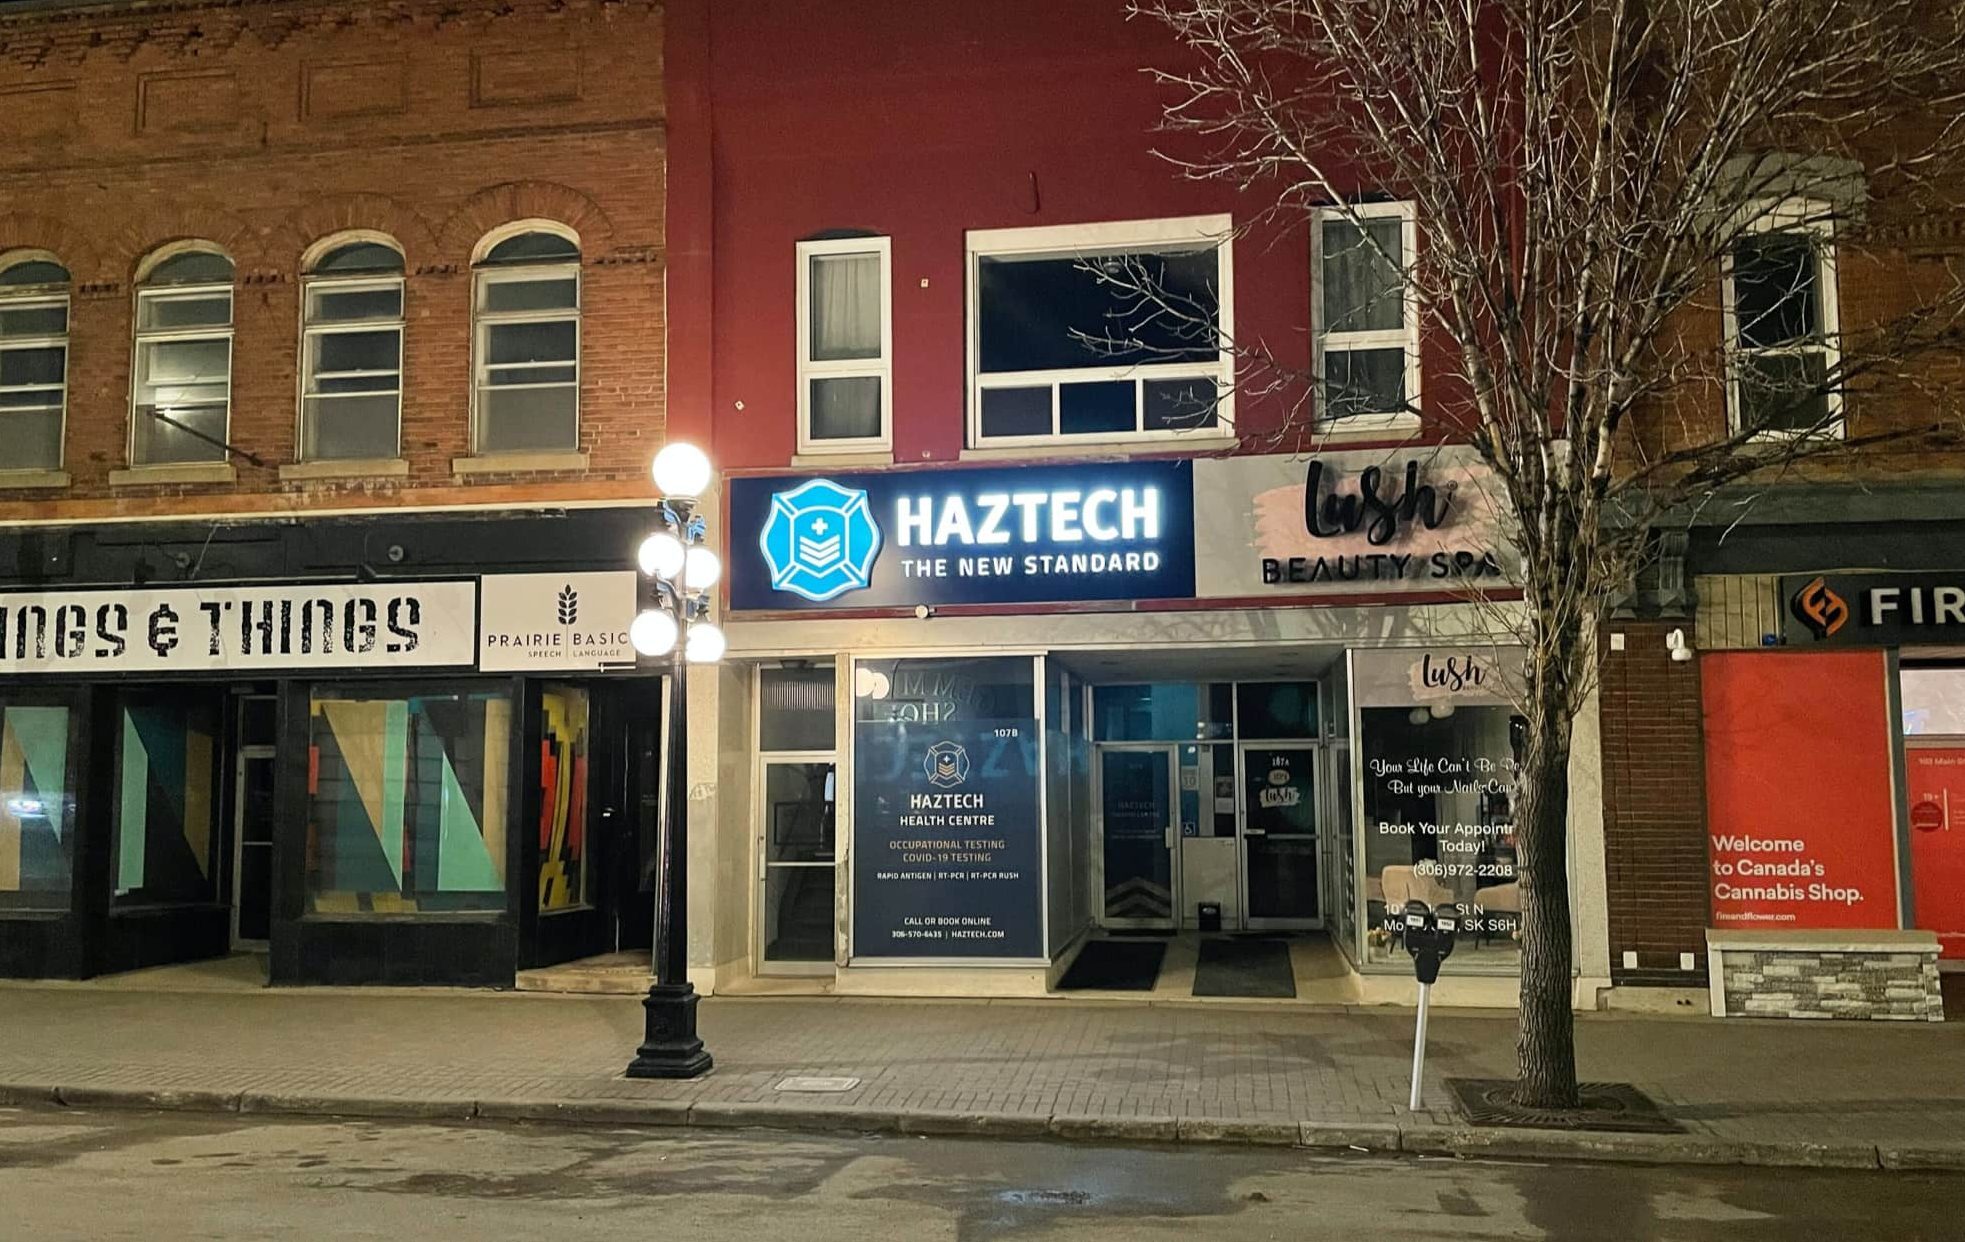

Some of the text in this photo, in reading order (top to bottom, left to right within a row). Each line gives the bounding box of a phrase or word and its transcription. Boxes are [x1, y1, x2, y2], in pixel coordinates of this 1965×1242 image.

[897, 488, 1159, 546] HAZTECH
[901, 551, 1160, 578] THE NEW STANDARD
[1262, 550, 1502, 584] BEAUTY SPA
[1870, 586, 1965, 625] FIR
[148, 603, 180, 658] &
[200, 596, 421, 656] THINGS
[488, 632, 562, 648] PRAIRIE
[528, 649, 621, 658] SPEECH LANGUAGE
[1370, 758, 1403, 777] Your
[1406, 757, 1435, 776] Life
[1437, 757, 1470, 773] Can't
[1474, 757, 1497, 772] Be
[1387, 779, 1414, 795] But
[1417, 784, 1442, 798] your
[911, 793, 984, 809] HAZTECH
[900, 815, 995, 826] HEALTH CENTRE
[1379, 822, 1416, 835] Book
[1418, 822, 1450, 835] Your
[889, 840, 1005, 849] OCCUPATIONAL TESTING
[1439, 840, 1485, 854] Today!
[1712, 835, 1805, 852] Welcome
[902, 853, 992, 862] COVID-19 TESTING
[1413, 864, 1513, 878] (306)972-2208
[1712, 859, 1825, 876] to Canada's
[877, 872, 1019, 880] RAPID ANTIGEN RT-PCR RT-PCR RUSH
[1714, 883, 1864, 906] Cannabis Shop.
[1456, 903, 1470, 916] St
[1473, 904, 1484, 916] N
[904, 917, 992, 926] CALL OR BOOK ONLINE
[1464, 919, 1485, 932] SK
[1488, 919, 1517, 932] S6H
[951, 930, 1005, 938] HAZTECH.COM
